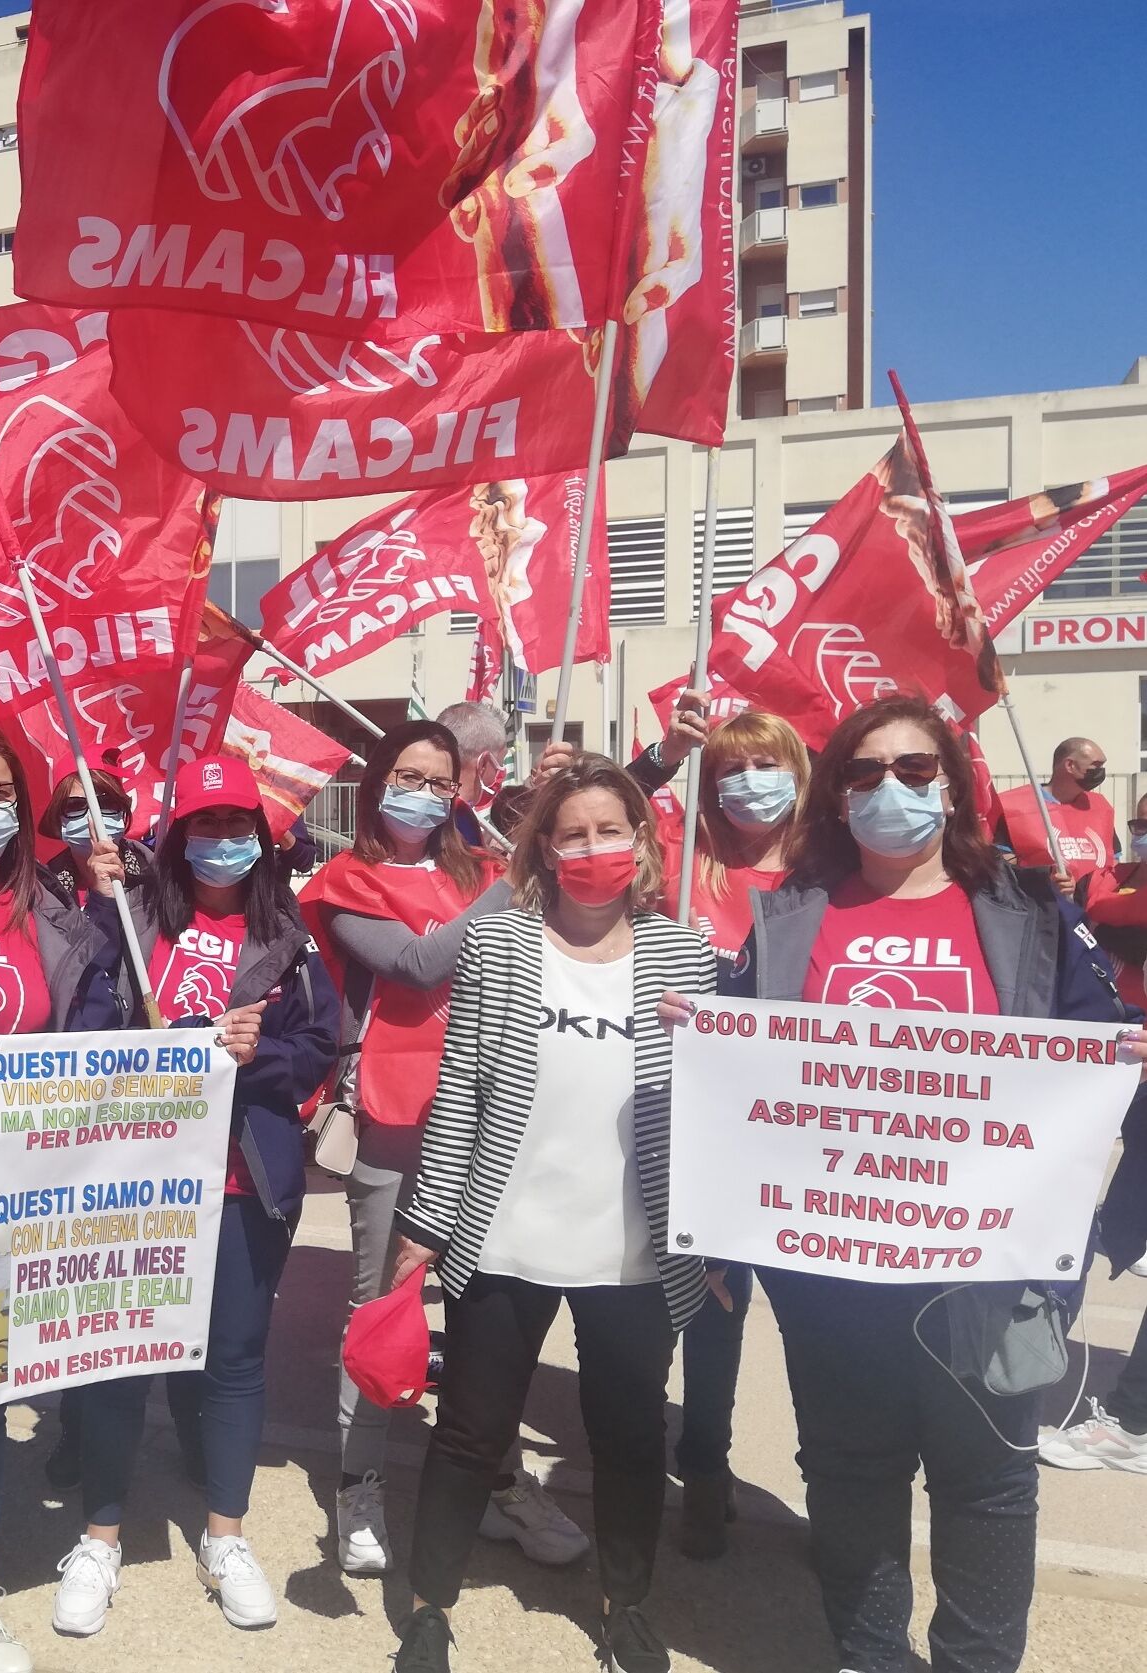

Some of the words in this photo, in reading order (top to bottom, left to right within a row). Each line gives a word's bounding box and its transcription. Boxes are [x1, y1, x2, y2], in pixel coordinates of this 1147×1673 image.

[178, 928, 243, 963] CGI
[845, 936, 960, 965] CGIL
[694, 1010, 757, 1038] 600
[768, 1015, 858, 1046] MILA
[869, 1023, 1117, 1065] LAVORATORI
[85, 1048, 149, 1077] SONO
[156, 1047, 211, 1073] EROI
[801, 1061, 991, 1101] INVISIBILI
[2, 1078, 106, 1107] VINCONO
[111, 1075, 204, 1098] SEMPRE
[1, 1111, 36, 1133] MA
[42, 1106, 91, 1130] NON
[95, 1100, 208, 1124] ESISTONO
[26, 1129, 70, 1150] PER
[76, 1121, 177, 1146] DAVVERO
[748, 1099, 970, 1144] ASPETTANO
[983, 1121, 1034, 1150] DA
[822, 1148, 844, 1173] 7
[854, 1152, 948, 1186] ANNI
[82, 1180, 155, 1212] SIAMO
[161, 1178, 203, 1206] NOI
[759, 1183, 792, 1210] IL
[804, 1188, 969, 1231] RINNOVO
[977, 1207, 1014, 1232] DI
[11, 1221, 43, 1257] CON
[46, 1220, 66, 1251] LA
[71, 1213, 138, 1248] SCHIENA
[143, 1210, 197, 1240] CURVA
[776, 1229, 983, 1271] CONTRATTO
[17, 1257, 51, 1294] PER
[56, 1251, 100, 1286] 500€
[103, 1249, 127, 1279] AL
[133, 1245, 186, 1277] MESE
[13, 1287, 69, 1328] SIAMO
[74, 1281, 116, 1315] VERI
[120, 1282, 133, 1308] E
[138, 1277, 193, 1307] REALI
[39, 1320, 71, 1344] MA
[77, 1311, 119, 1337] PER
[126, 1308, 154, 1329] TE
[14, 1358, 59, 1387] NON
[66, 1341, 185, 1376] ESISTIAMO
